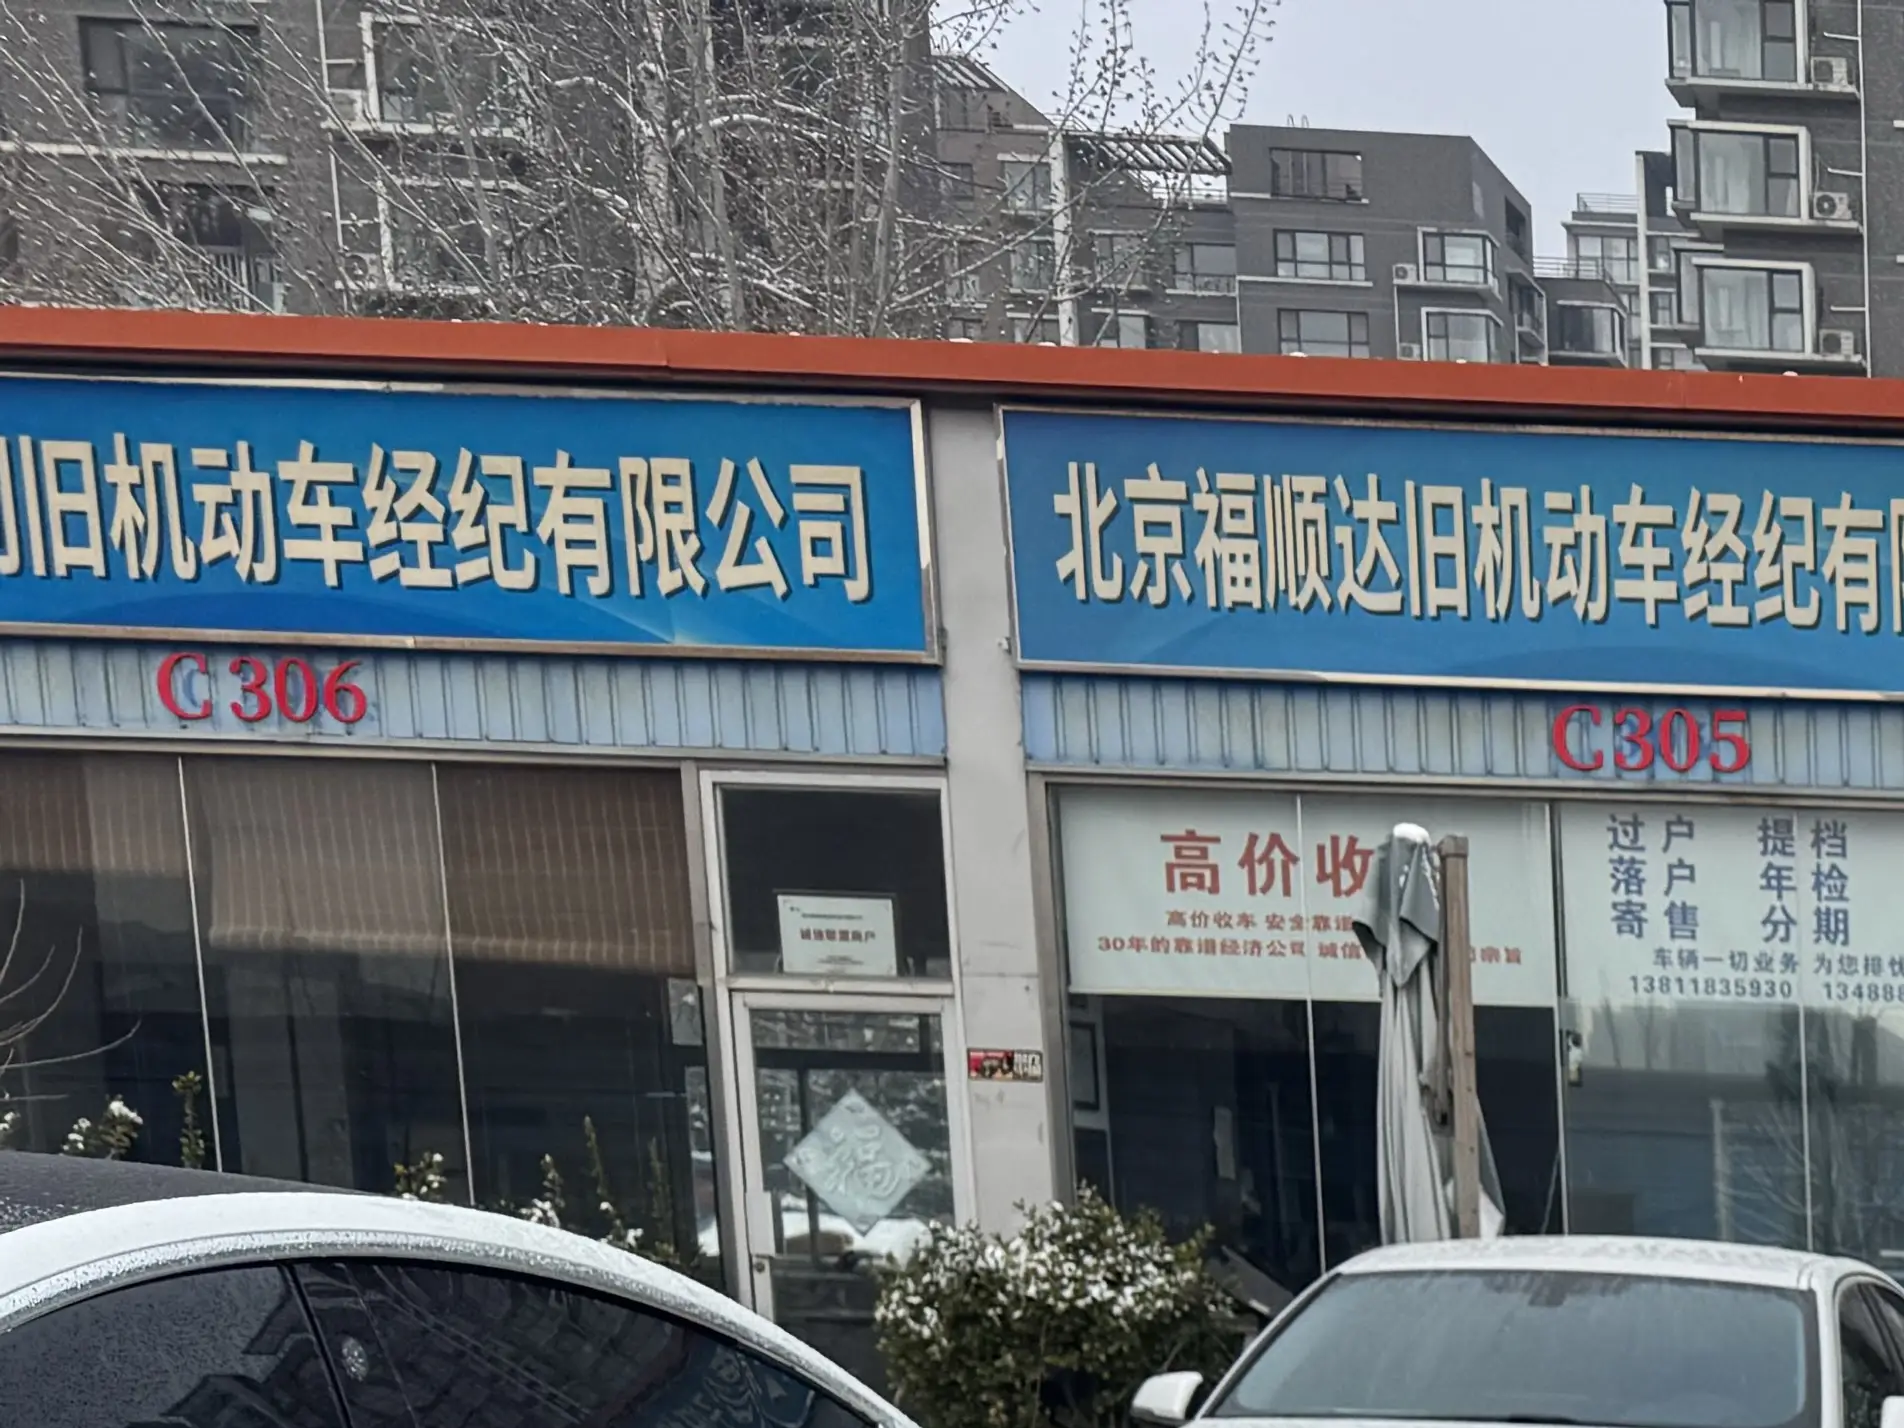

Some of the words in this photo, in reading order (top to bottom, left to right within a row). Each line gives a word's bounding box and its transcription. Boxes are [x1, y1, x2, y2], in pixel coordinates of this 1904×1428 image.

[157, 652, 367, 723] C306
[1552, 705, 1752, 772] C305
[1607, 813, 1694, 853] 过户
[1758, 817, 1847, 860] 提档
[1160, 829, 1375, 897] 高价收
[1609, 856, 1696, 897] 落户
[1759, 862, 1850, 902] 年检
[1166, 910, 1256, 930] 高价收车
[1611, 900, 1699, 941] 寄售
[1761, 905, 1849, 946] 分期
[1653, 948, 1799, 974] 车辆一切业务
[1630, 975, 1793, 999] 13811835930
